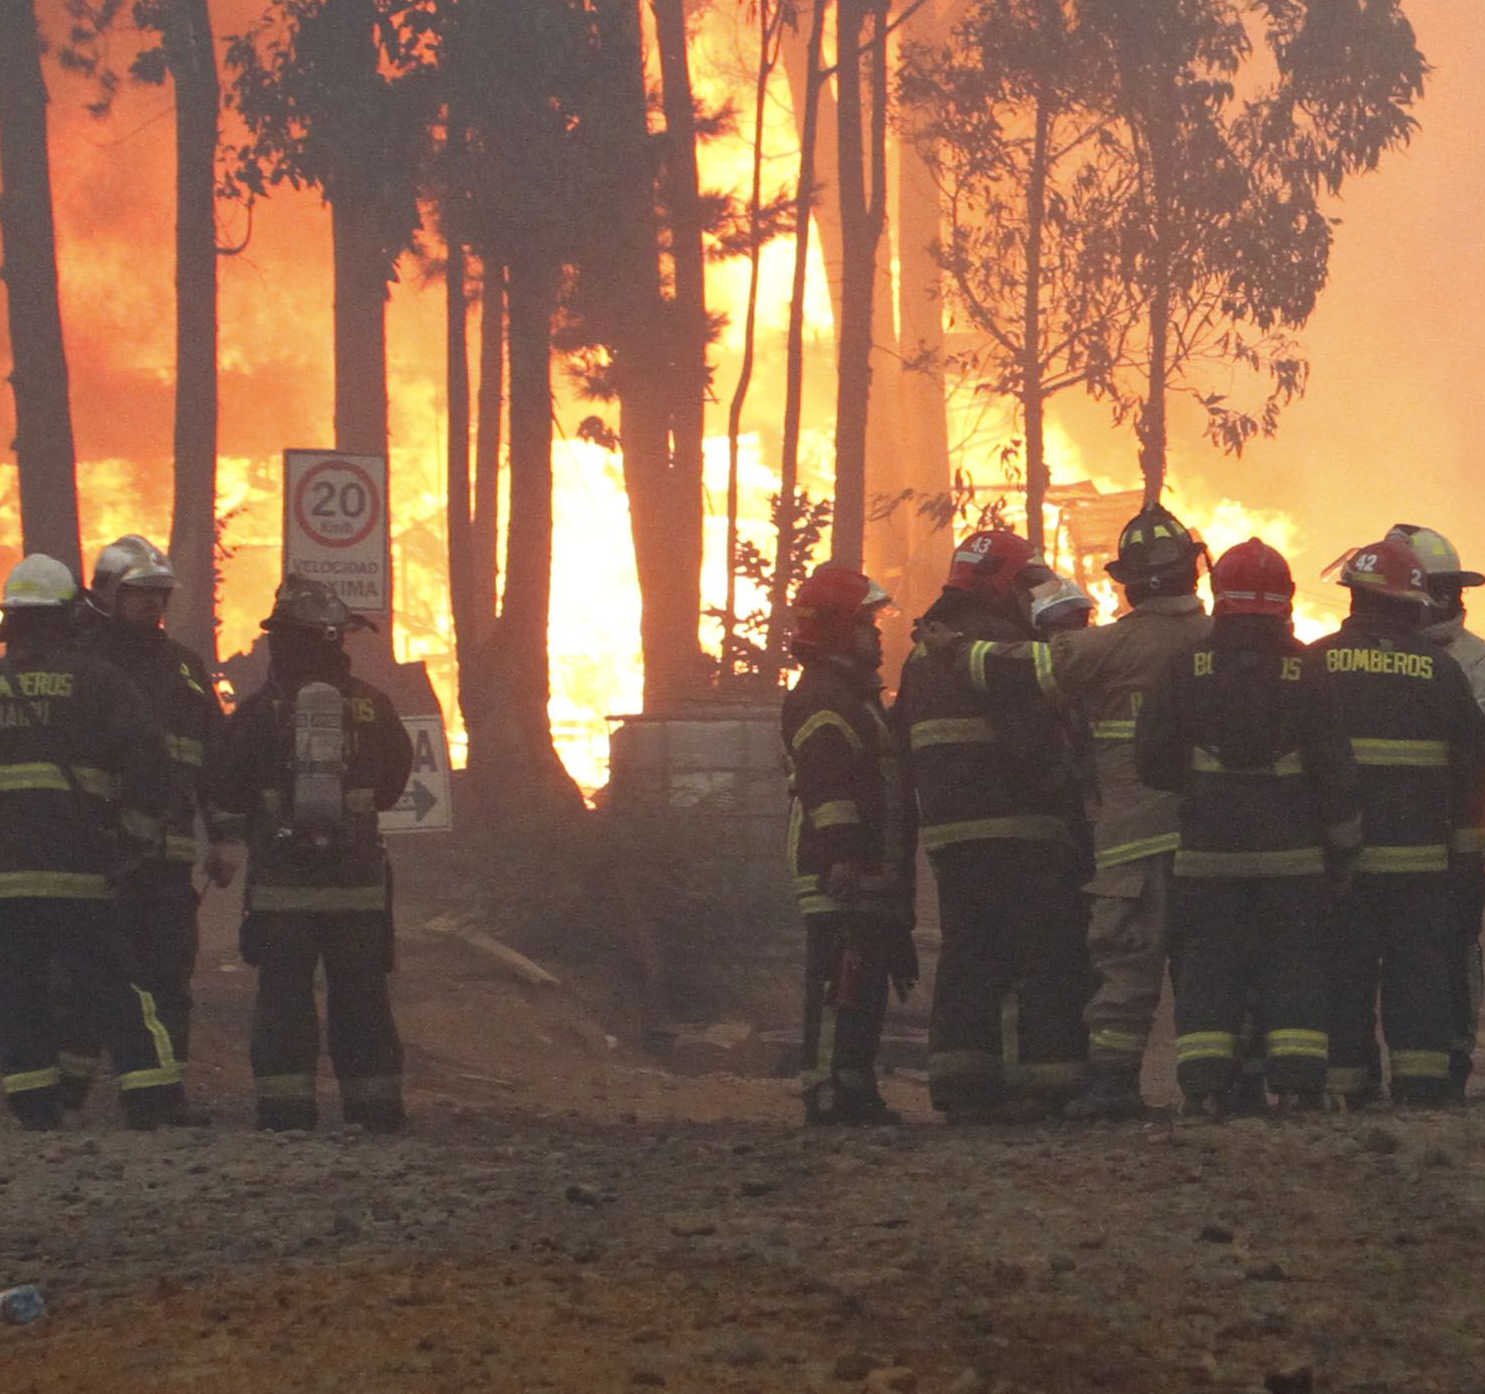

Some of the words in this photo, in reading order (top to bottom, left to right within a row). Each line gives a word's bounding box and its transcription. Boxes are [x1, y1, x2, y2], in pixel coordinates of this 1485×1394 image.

[311, 481, 365, 518] 20
[971, 536, 992, 554] 43
[292, 559, 379, 575] VELOCIDAD
[1355, 553, 1378, 572] 42
[1410, 568, 1422, 587] 2
[1326, 648, 1434, 680] BOMBEROS
